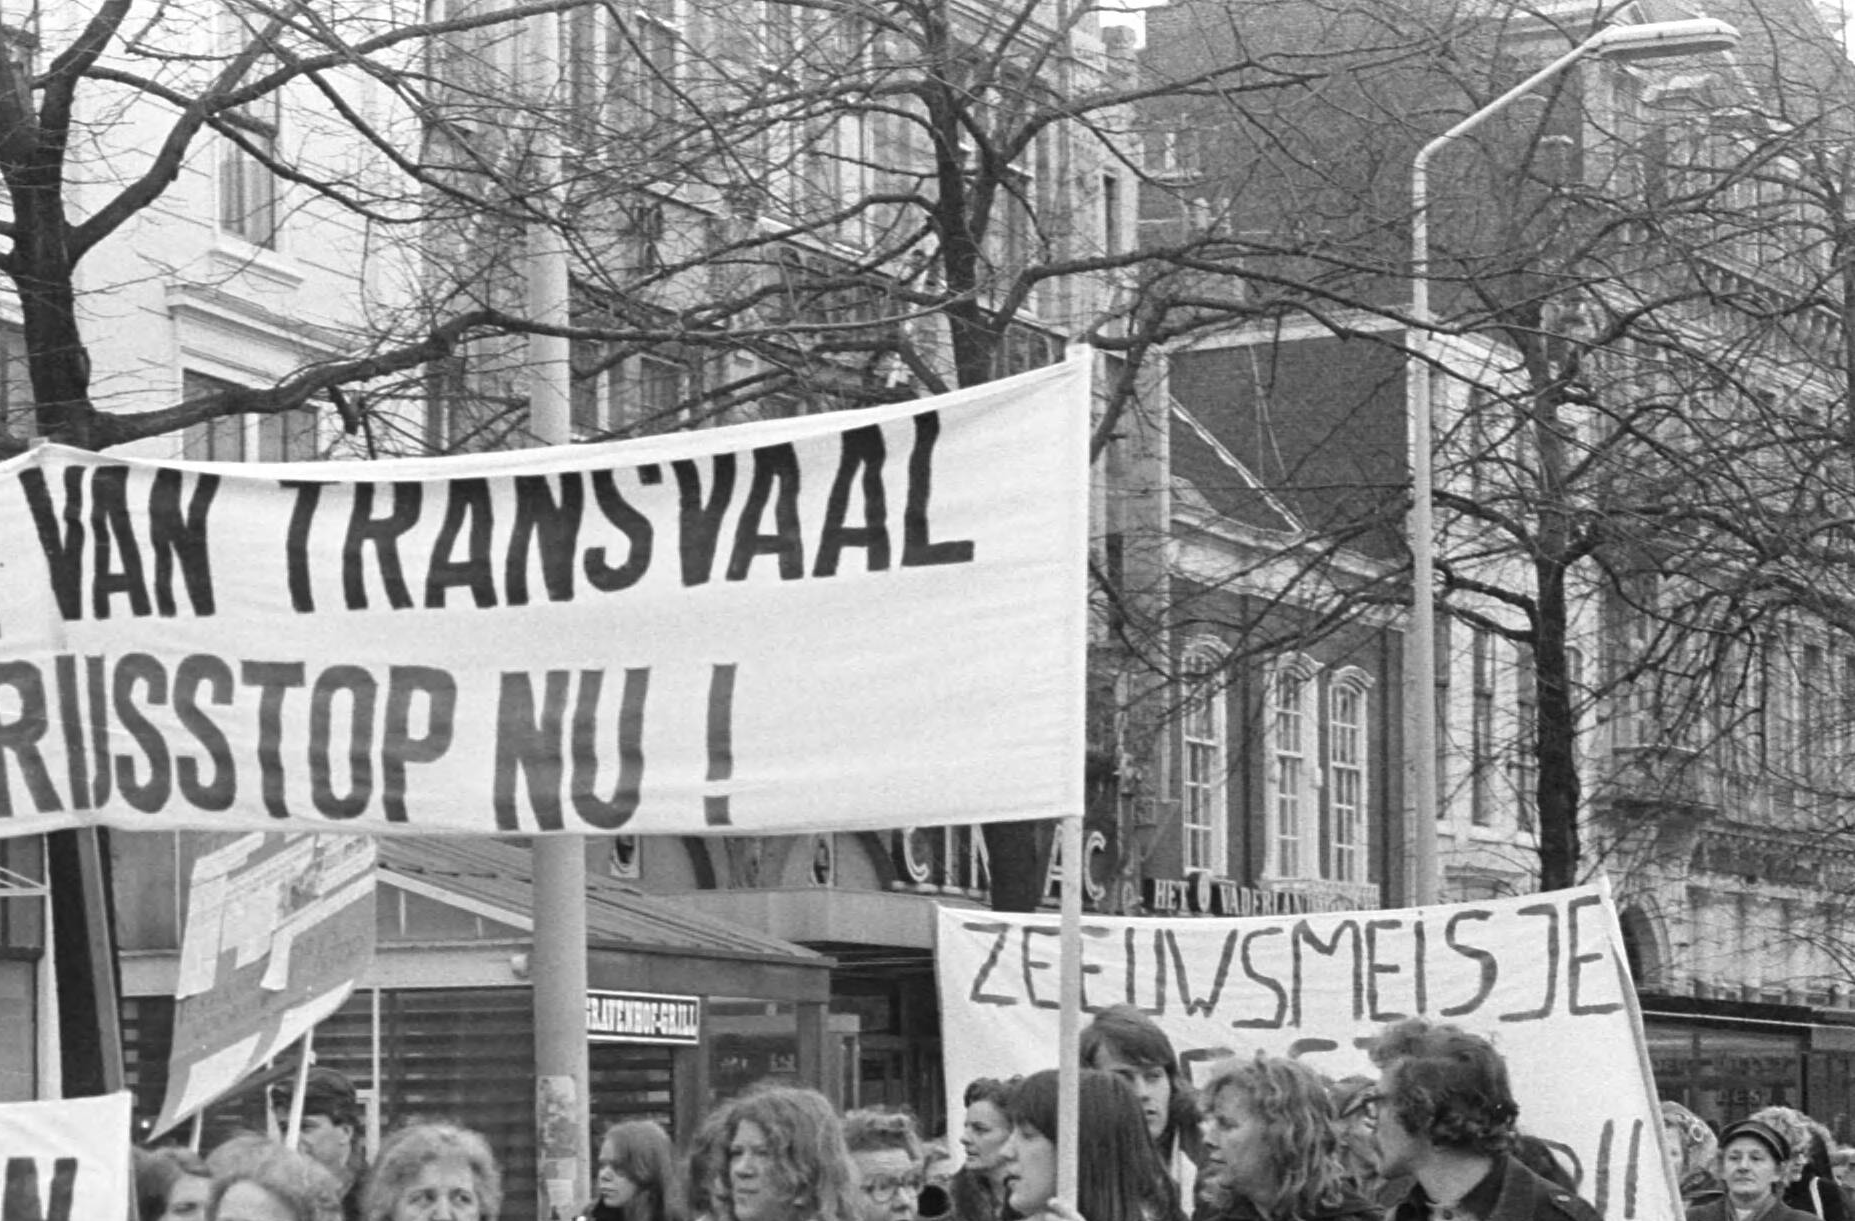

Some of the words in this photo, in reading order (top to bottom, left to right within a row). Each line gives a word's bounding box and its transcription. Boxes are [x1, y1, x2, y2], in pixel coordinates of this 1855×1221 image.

[18, 465, 221, 621] VAN
[278, 411, 975, 614] TRANSVAAL
[493, 667, 651, 831] NU
[704, 663, 738, 826] !
[1154, 878, 1190, 911] HET
